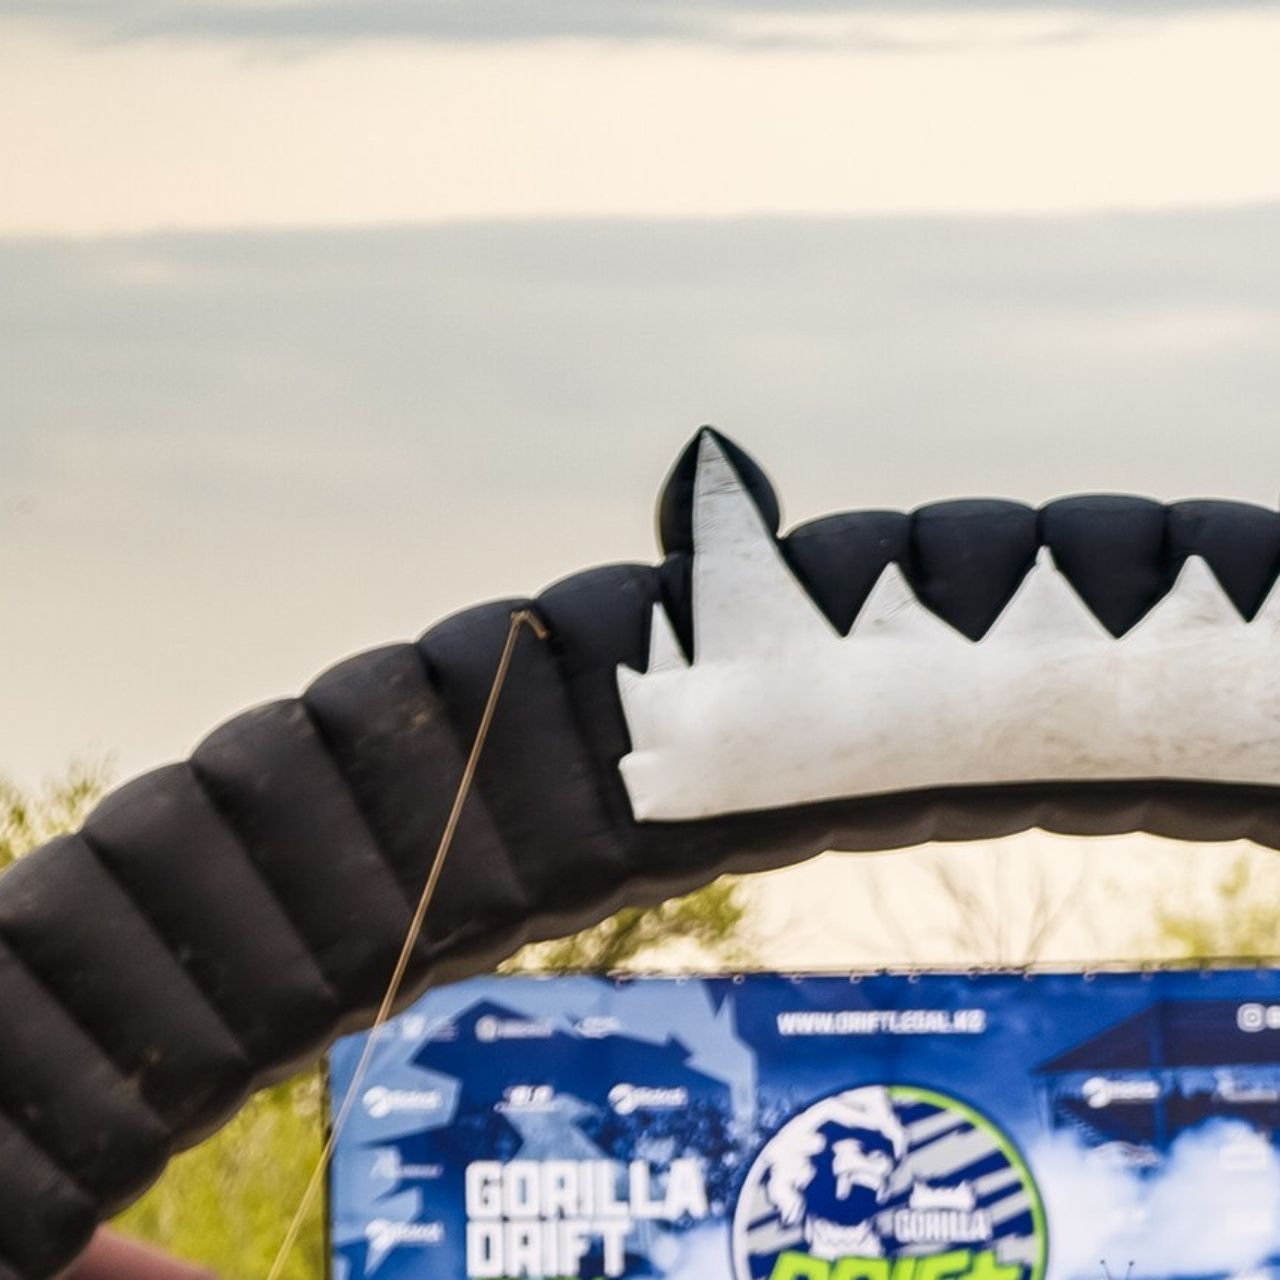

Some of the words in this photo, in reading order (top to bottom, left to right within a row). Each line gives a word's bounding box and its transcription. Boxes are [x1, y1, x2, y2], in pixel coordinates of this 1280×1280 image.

[466, 1159, 709, 1219] GORILLA
[467, 1219, 632, 1278] DRIFT
[894, 1208, 993, 1243] GORILLA
